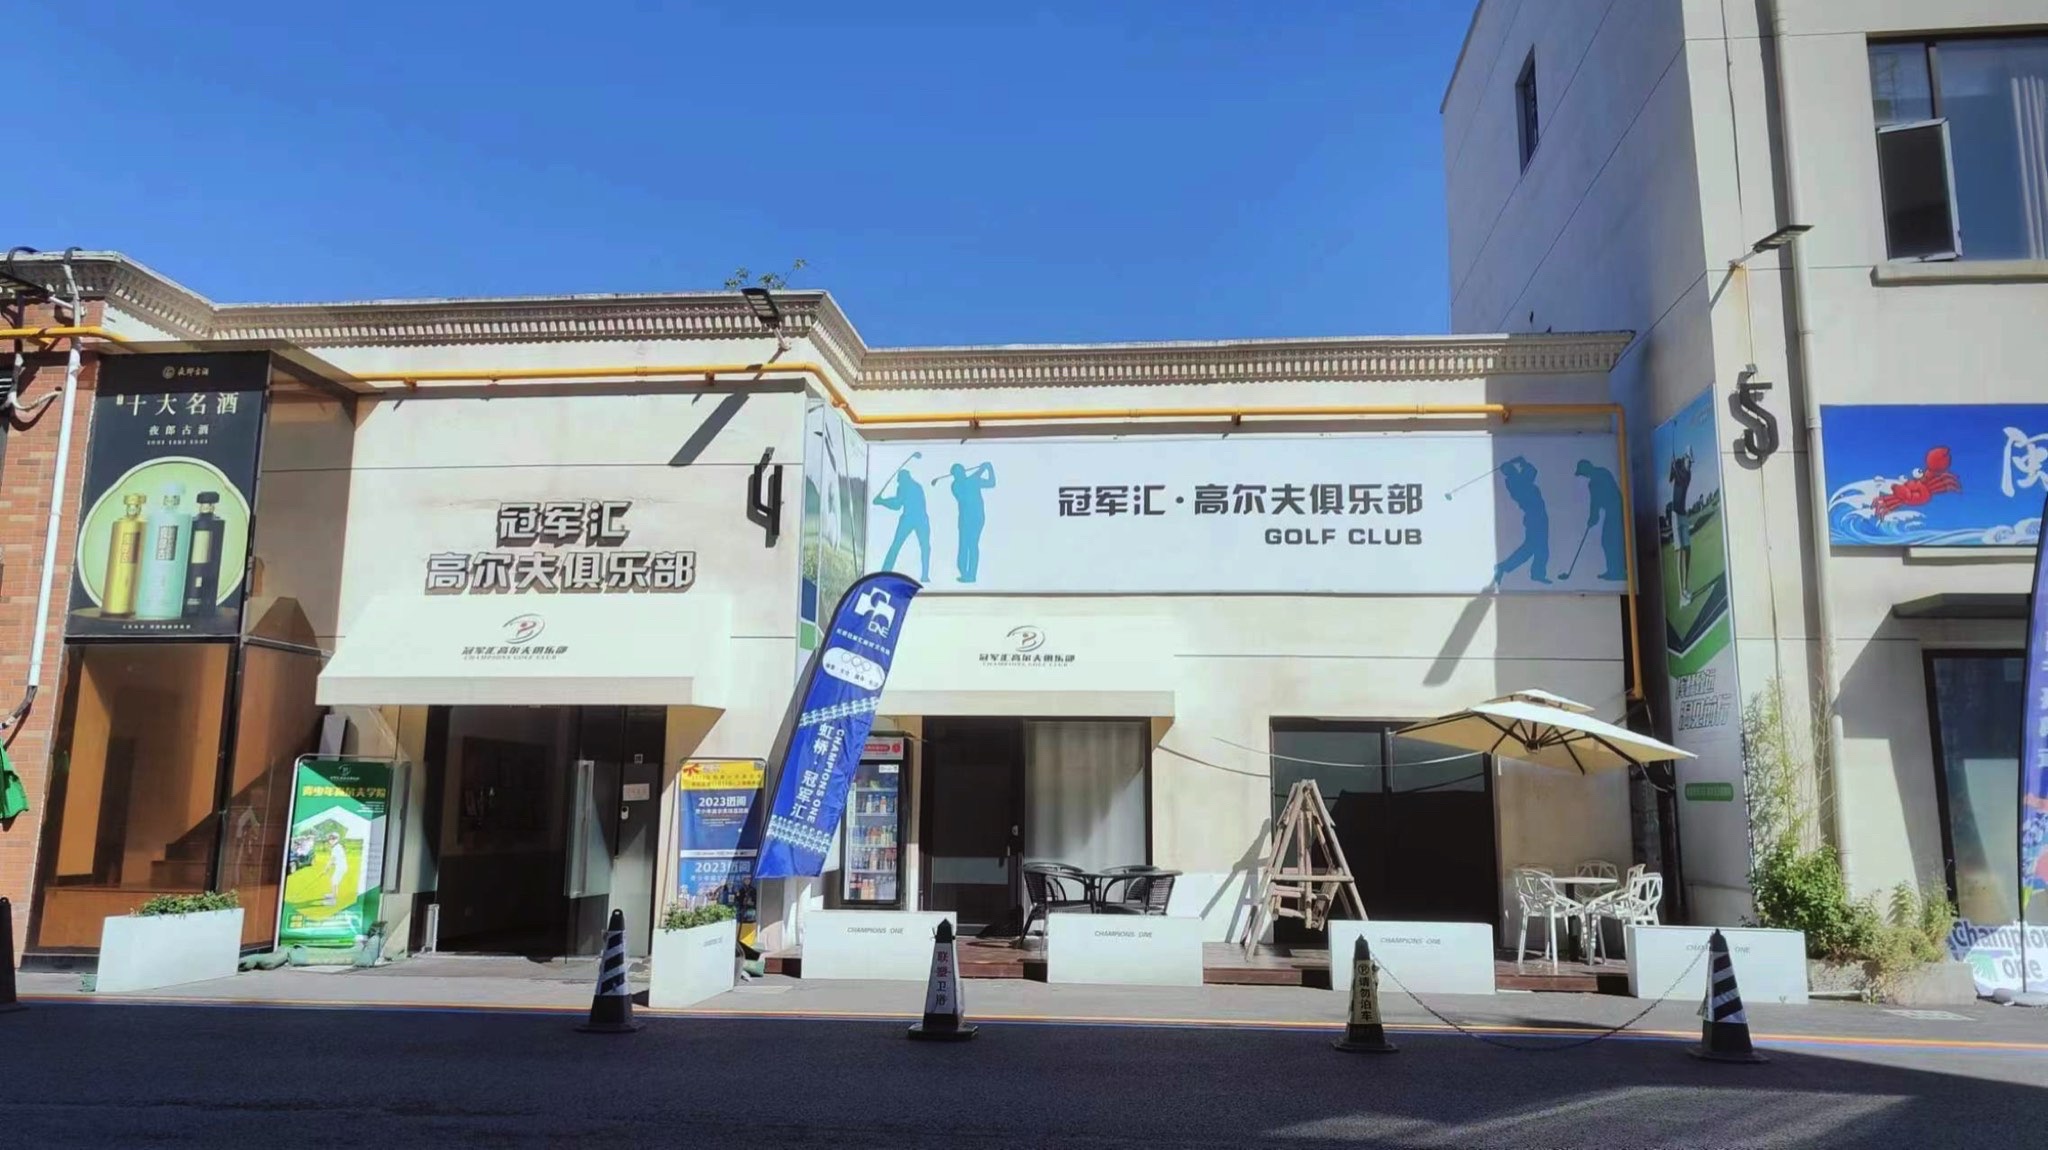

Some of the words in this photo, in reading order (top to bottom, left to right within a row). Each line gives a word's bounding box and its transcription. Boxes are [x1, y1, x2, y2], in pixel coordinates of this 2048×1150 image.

[126, 391, 240, 416] 十大名酒
[1058, 483, 1424, 517] 冠军汇·高尔夫俱乐部
[497, 500, 632, 546] 冠军汇
[1264, 528, 1337, 546] GOLF
[1347, 528, 1423, 546] CLUB
[425, 551, 696, 593] 高尔夫俱乐部
[815, 728, 845, 798] CHAMPIONS
[806, 799, 822, 823] ONE
[1359, 976, 1373, 1021] 请勿泊车
